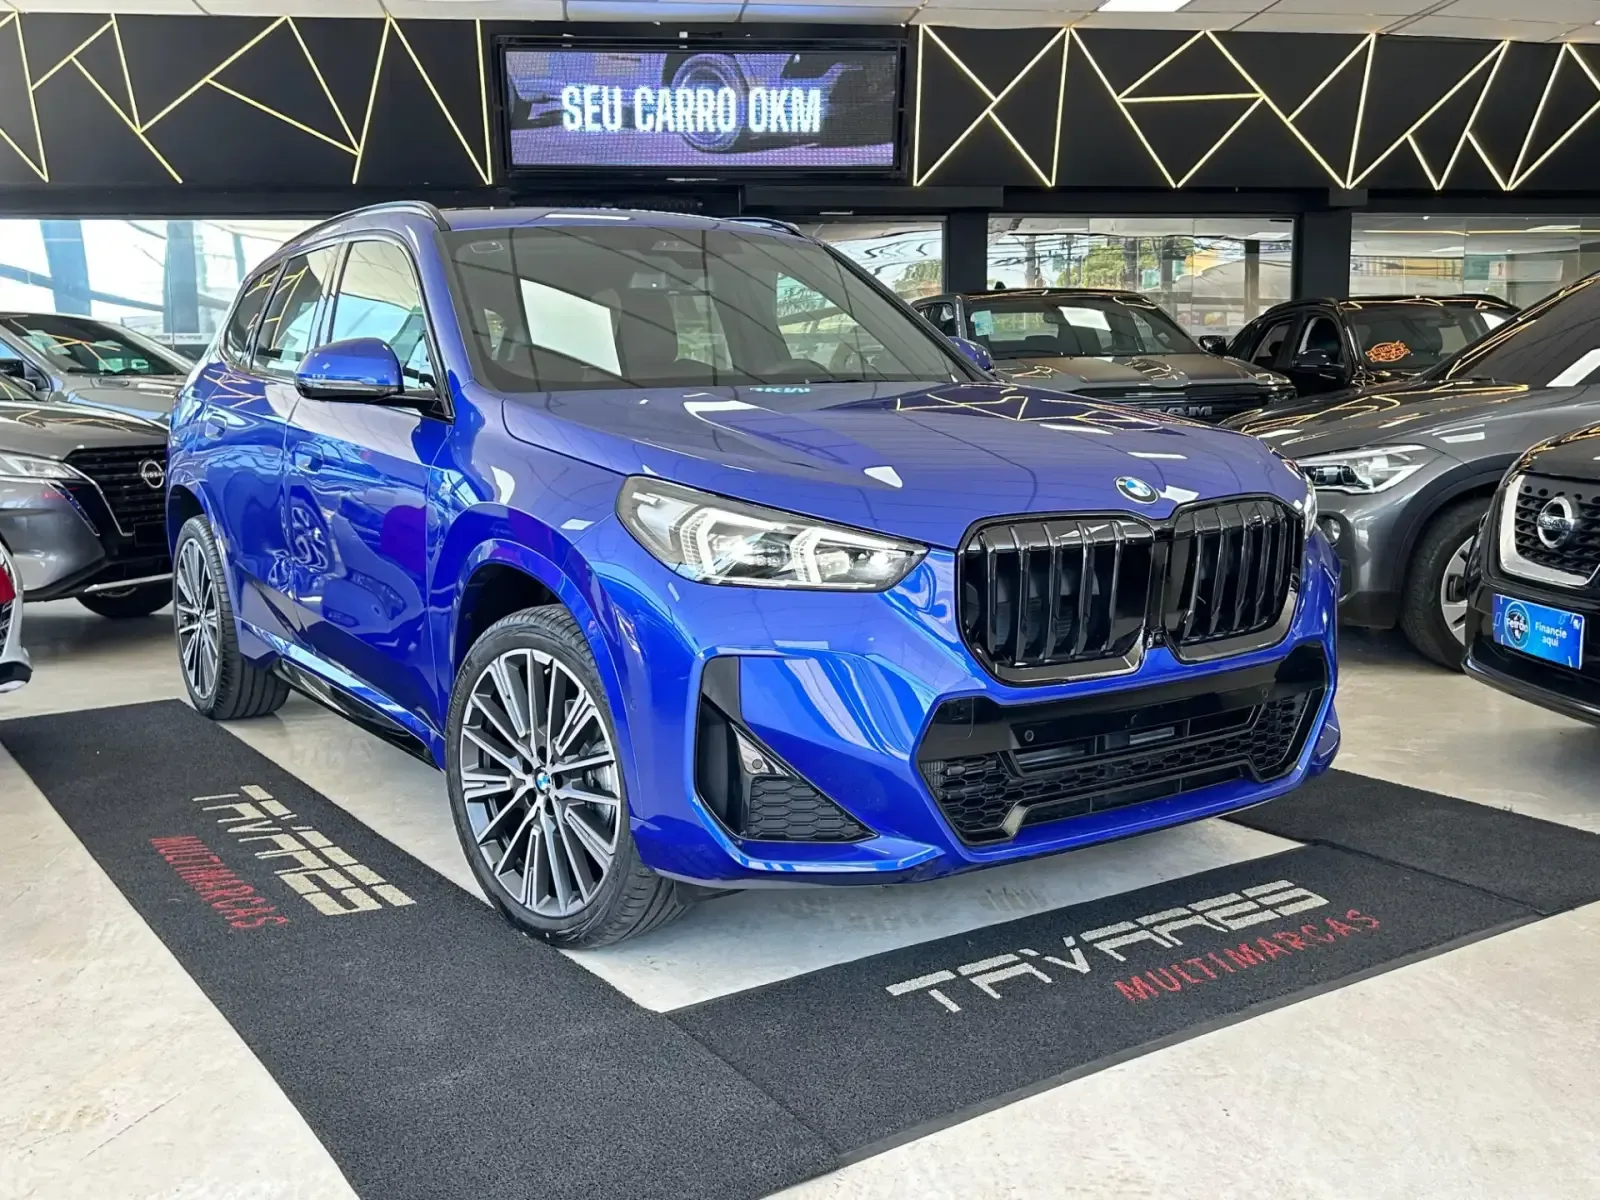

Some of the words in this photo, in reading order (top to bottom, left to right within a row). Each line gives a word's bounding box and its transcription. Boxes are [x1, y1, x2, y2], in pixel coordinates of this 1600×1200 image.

[561, 84, 622, 133] SEU
[634, 84, 737, 133] CARRO
[1144, 405, 1213, 417] AM
[1535, 621, 1568, 639] Financie
[1541, 635, 1559, 648] aqui
[149, 835, 289, 929] MULTIMARCAS
[192, 784, 417, 916] TAVARES
[885, 879, 1331, 1013] TAVARES
[1113, 908, 1381, 1005] MULTIMARCAS
